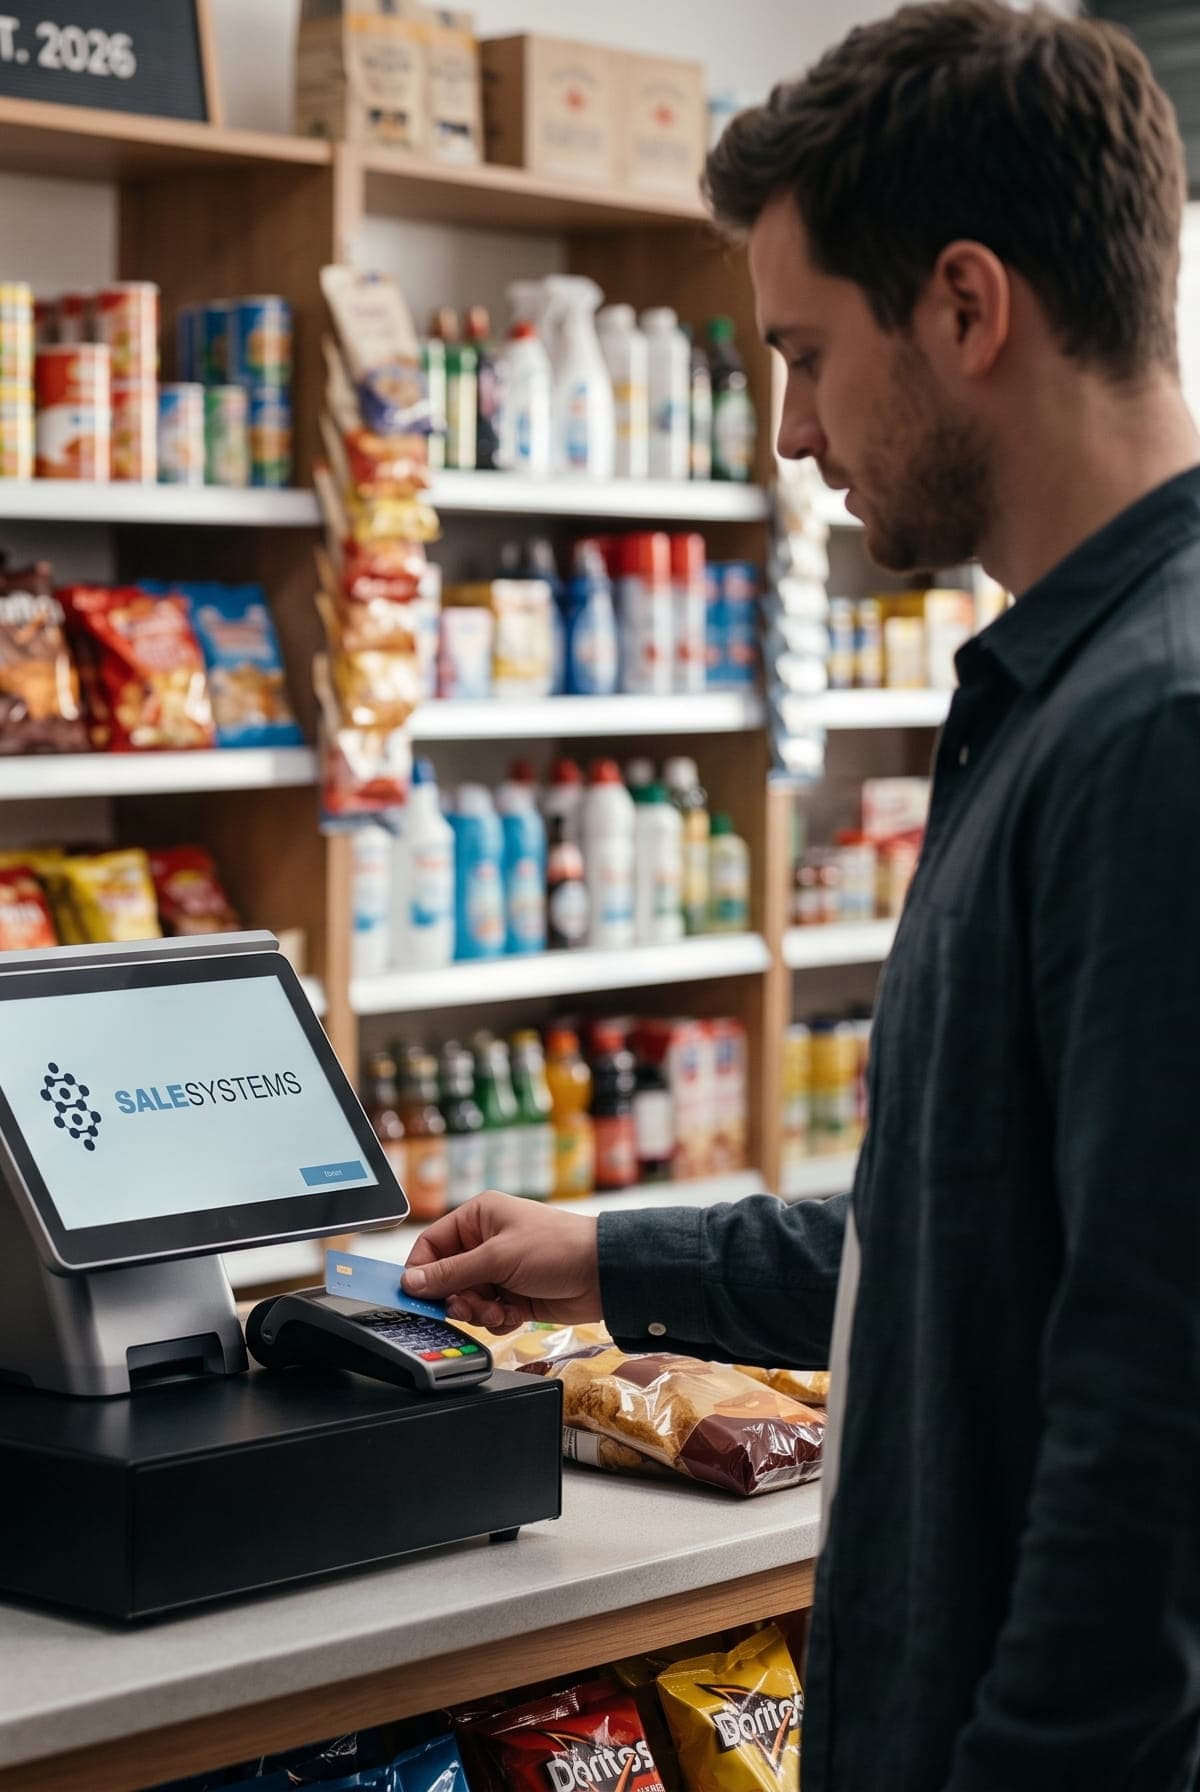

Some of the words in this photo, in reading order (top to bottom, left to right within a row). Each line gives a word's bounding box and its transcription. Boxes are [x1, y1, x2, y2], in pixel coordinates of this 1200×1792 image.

[35, 21, 138, 79] 2026
[114, 1070, 302, 1115] SALESYSTEMS
[546, 1740, 655, 1792] Doritos
